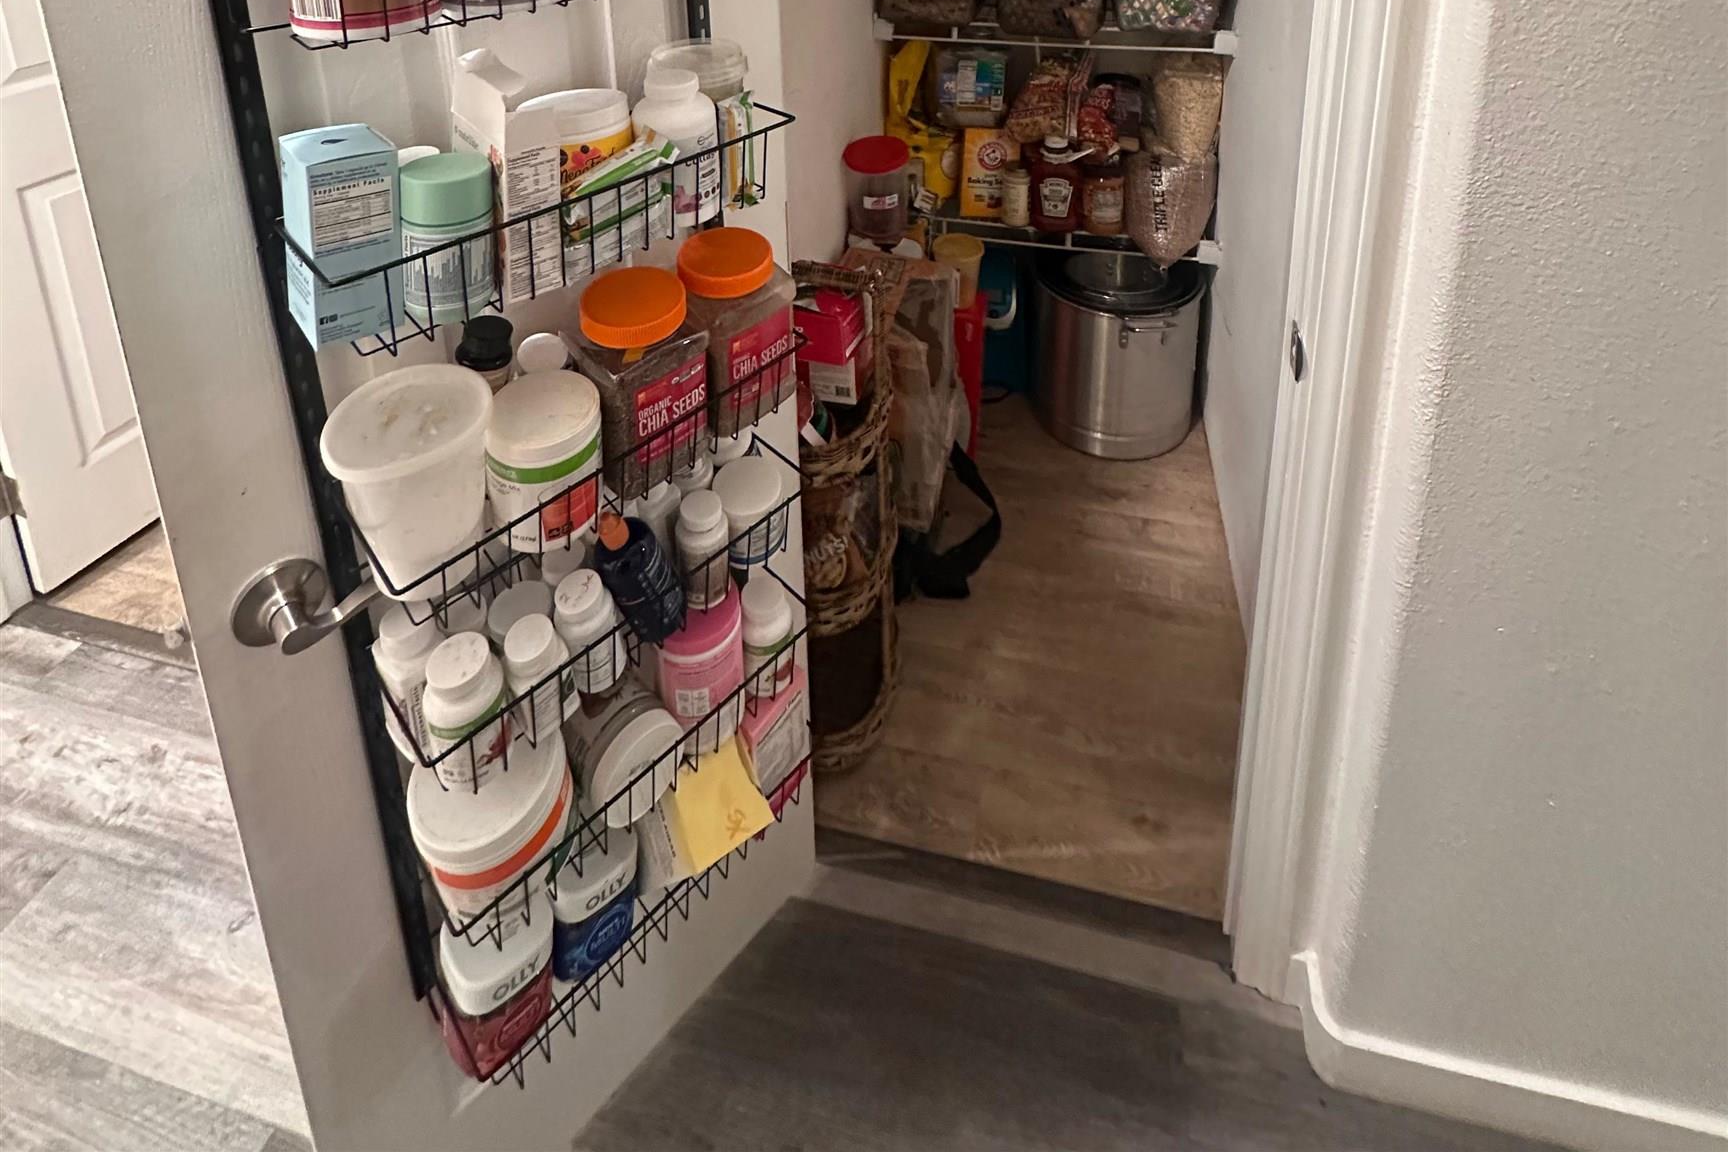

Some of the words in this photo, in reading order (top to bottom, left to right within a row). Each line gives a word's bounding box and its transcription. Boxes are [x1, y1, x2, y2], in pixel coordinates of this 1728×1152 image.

[733, 356, 758, 380] CHIA
[760, 335, 788, 366] SEEDS
[638, 395, 673, 421] ORGANIC
[638, 413, 669, 437] CHIA
[672, 383, 706, 420] SEEDS
[585, 871, 627, 911] OLLY
[493, 951, 541, 1001] OLLY
